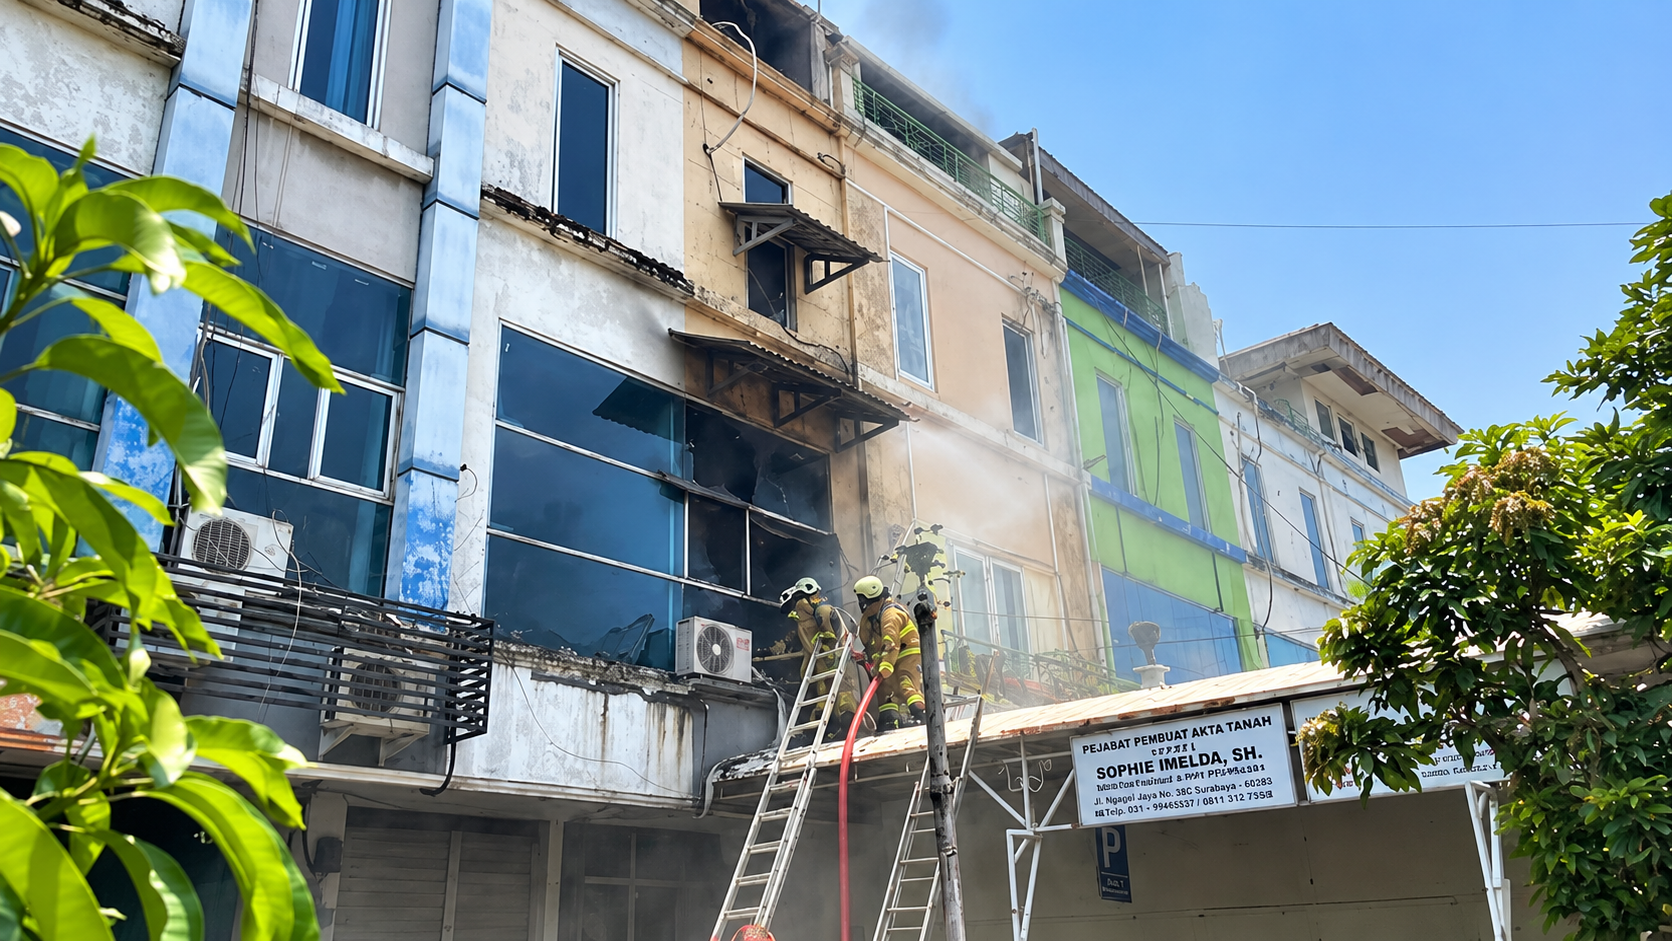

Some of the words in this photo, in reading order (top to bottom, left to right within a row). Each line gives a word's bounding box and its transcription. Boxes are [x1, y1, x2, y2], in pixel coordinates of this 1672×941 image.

[1082, 738, 1131, 754] PEJABAT
[1134, 728, 1188, 747] PEMBUAT
[1191, 723, 1225, 738] AKTA
[1225, 716, 1272, 732] TANAH
[1096, 760, 1155, 780] SOPHIE
[1159, 751, 1228, 771] IMELDA,
[1232, 745, 1263, 762] SH.
[1127, 804, 1144, 814] 031
[1202, 795, 1225, 806] 0811
[1227, 793, 1246, 803] 312
[1159, 790, 1174, 799] No.
[1175, 787, 1193, 797] 38C
[1194, 783, 1237, 795] Surabaya
[1244, 777, 1273, 788] 60283
[1101, 827, 1121, 868] P
